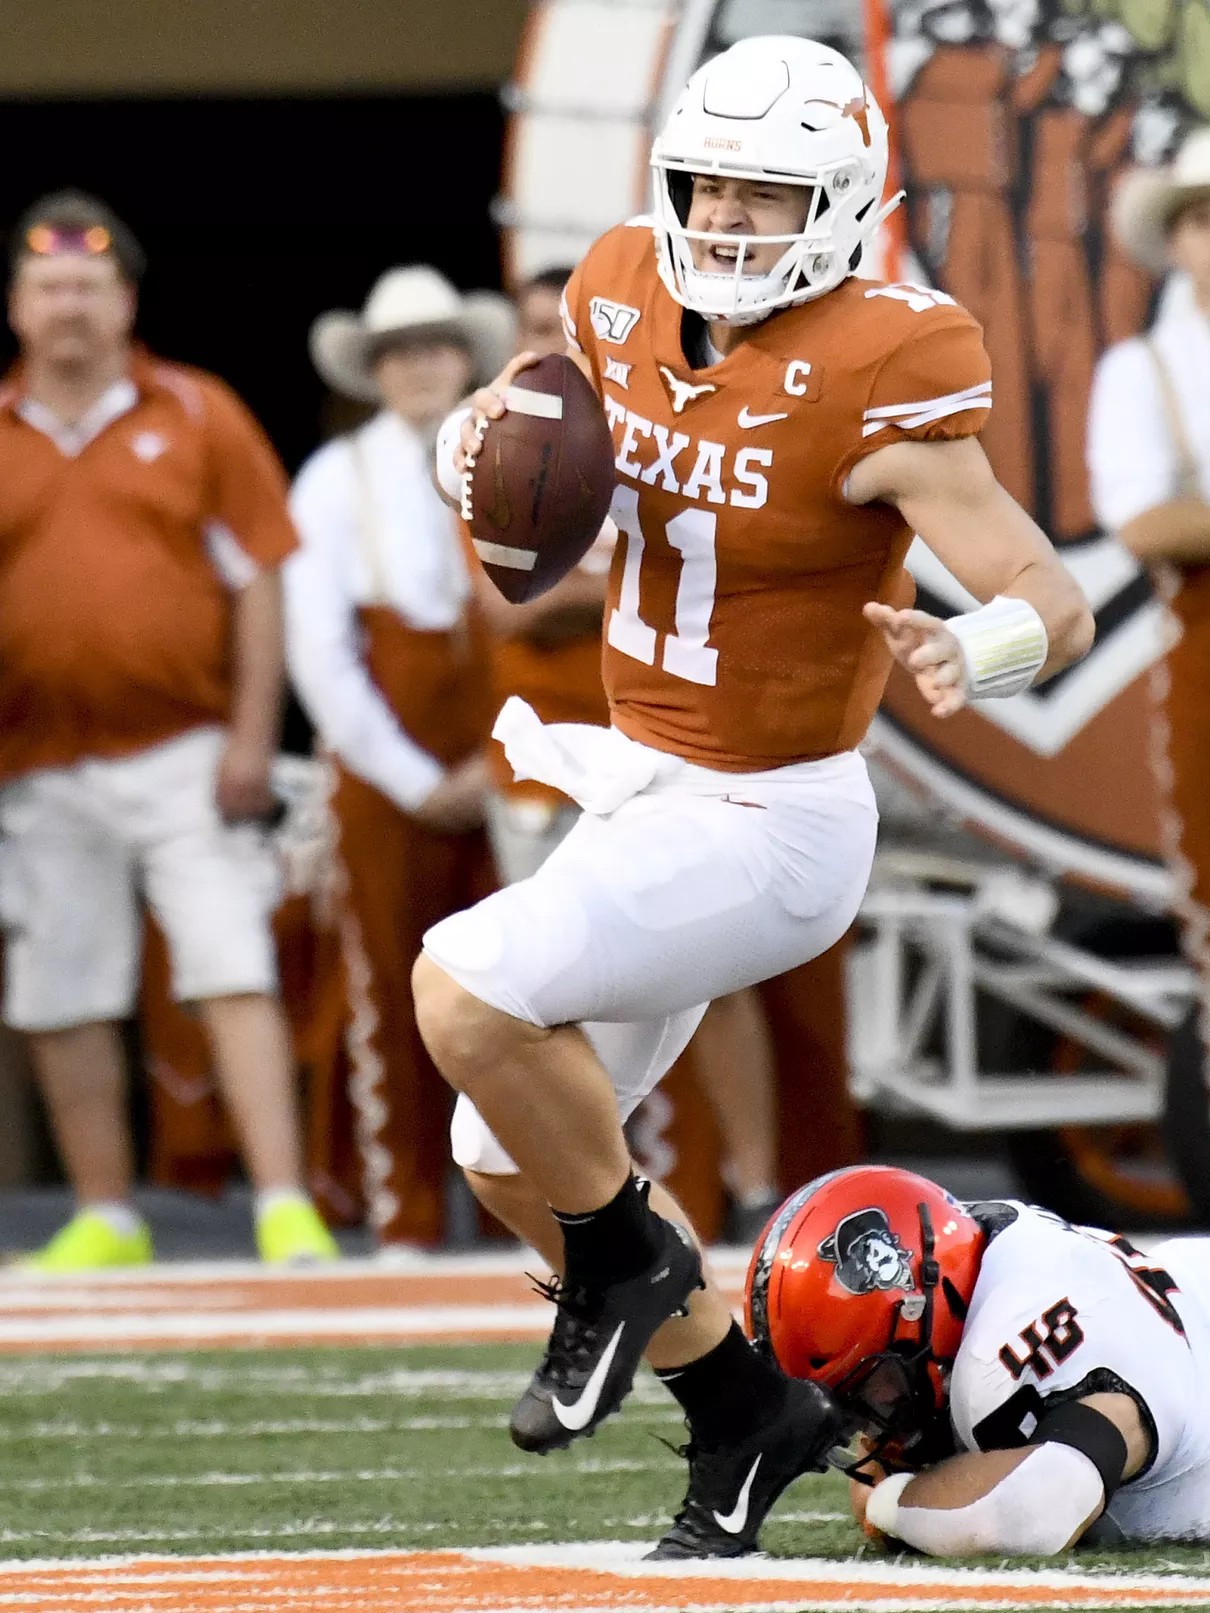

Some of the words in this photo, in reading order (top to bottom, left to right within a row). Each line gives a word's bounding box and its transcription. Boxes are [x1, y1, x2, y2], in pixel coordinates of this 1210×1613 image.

[783, 360, 811, 396] C
[605, 394, 773, 509] TEXAS
[607, 483, 719, 687] 11
[998, 1296, 1085, 1382] 48
